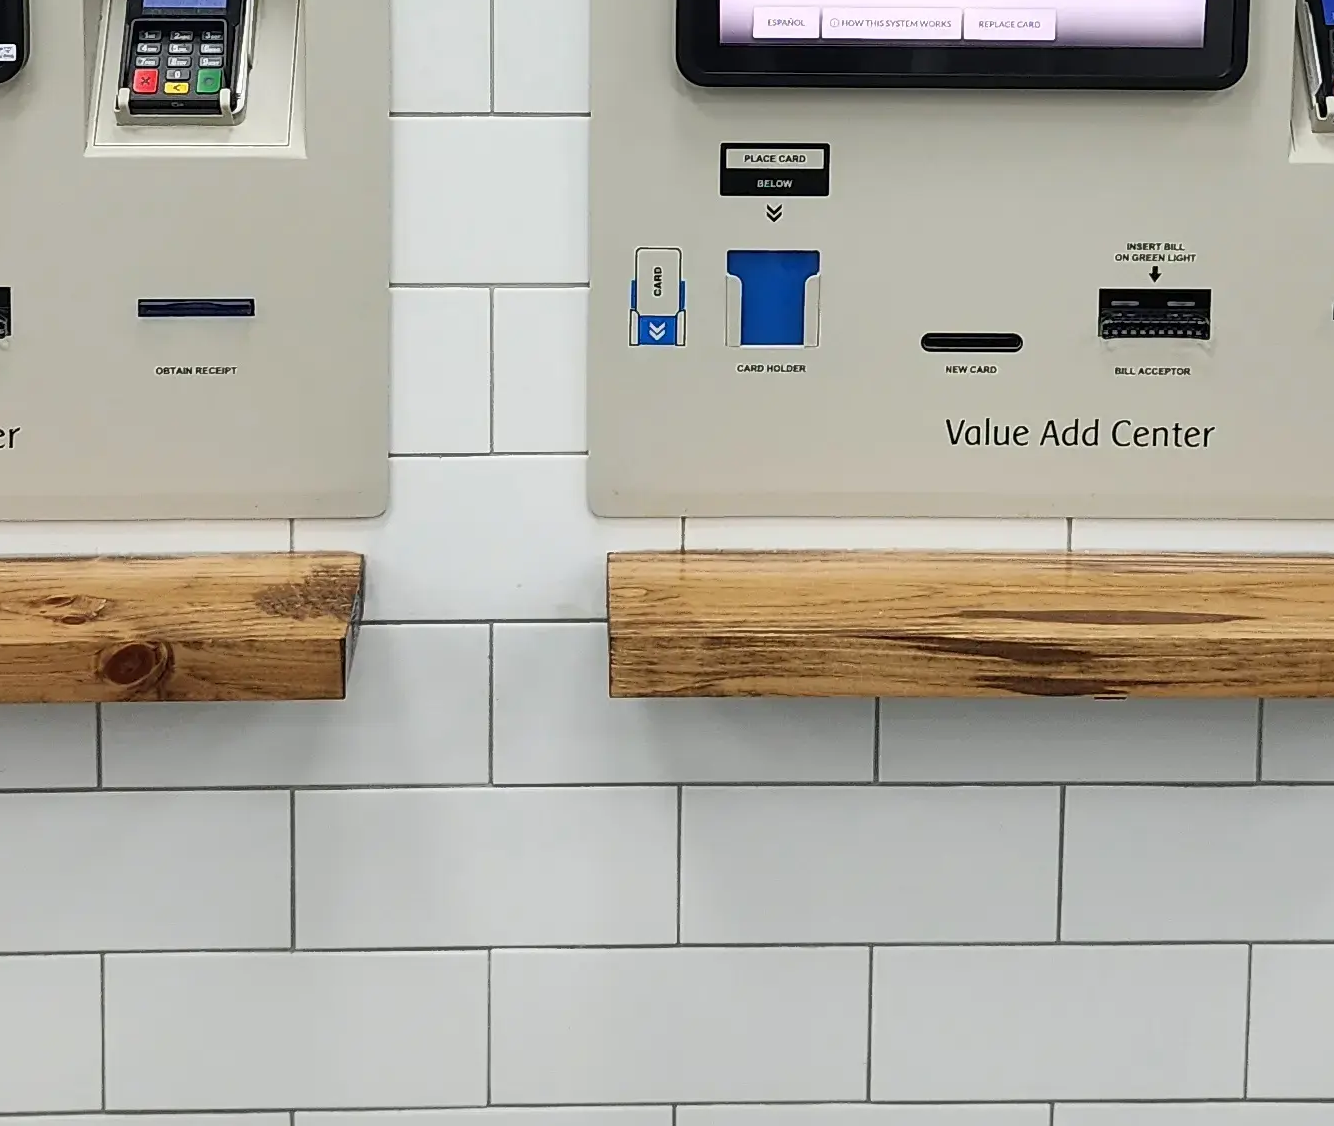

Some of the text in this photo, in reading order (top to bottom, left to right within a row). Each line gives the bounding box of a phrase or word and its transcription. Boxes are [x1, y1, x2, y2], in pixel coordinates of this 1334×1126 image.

[1115, 367, 1136, 375] BILL
[946, 418, 1215, 447] Value Add Center
